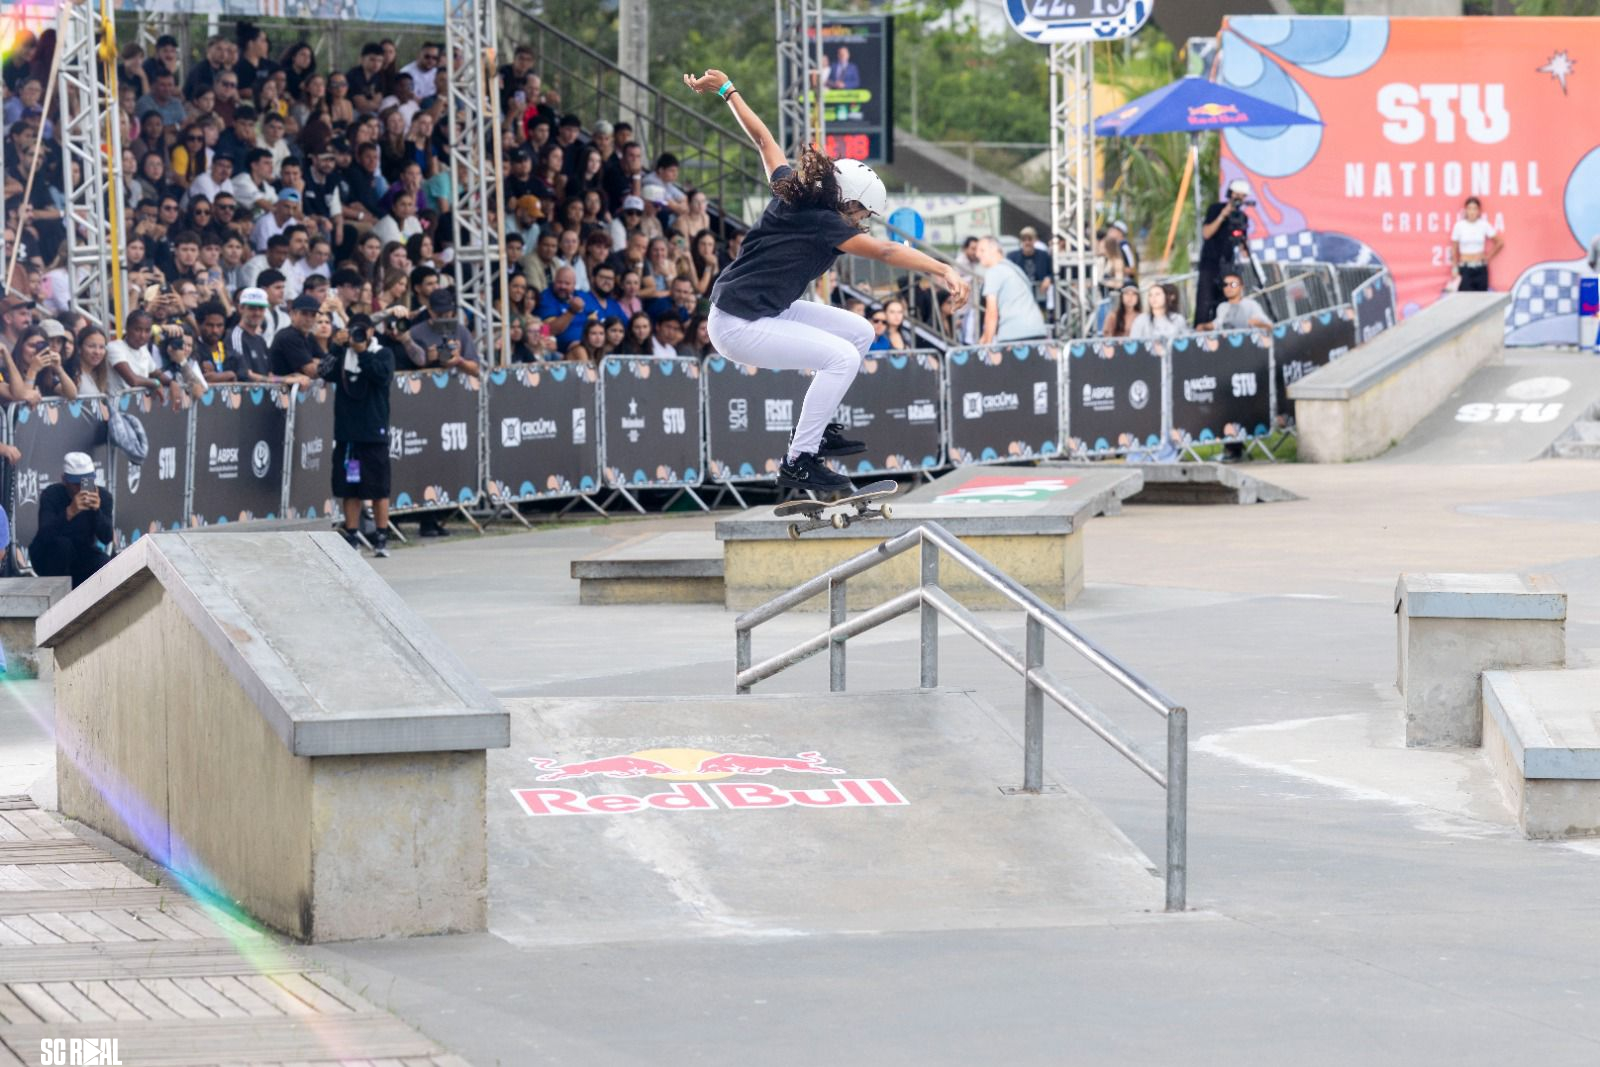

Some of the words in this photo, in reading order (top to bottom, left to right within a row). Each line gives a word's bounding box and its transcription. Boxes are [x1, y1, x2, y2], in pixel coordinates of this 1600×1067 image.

[1377, 83, 1510, 144] STU
[1345, 161, 1542, 197] NATIONAL
[1231, 372, 1257, 397] STU
[662, 407, 686, 434] STU
[1454, 402, 1563, 423] STU
[440, 421, 468, 452] STU
[158, 446, 176, 481] STU
[511, 783, 719, 816] Red
[709, 778, 910, 809] Bull
